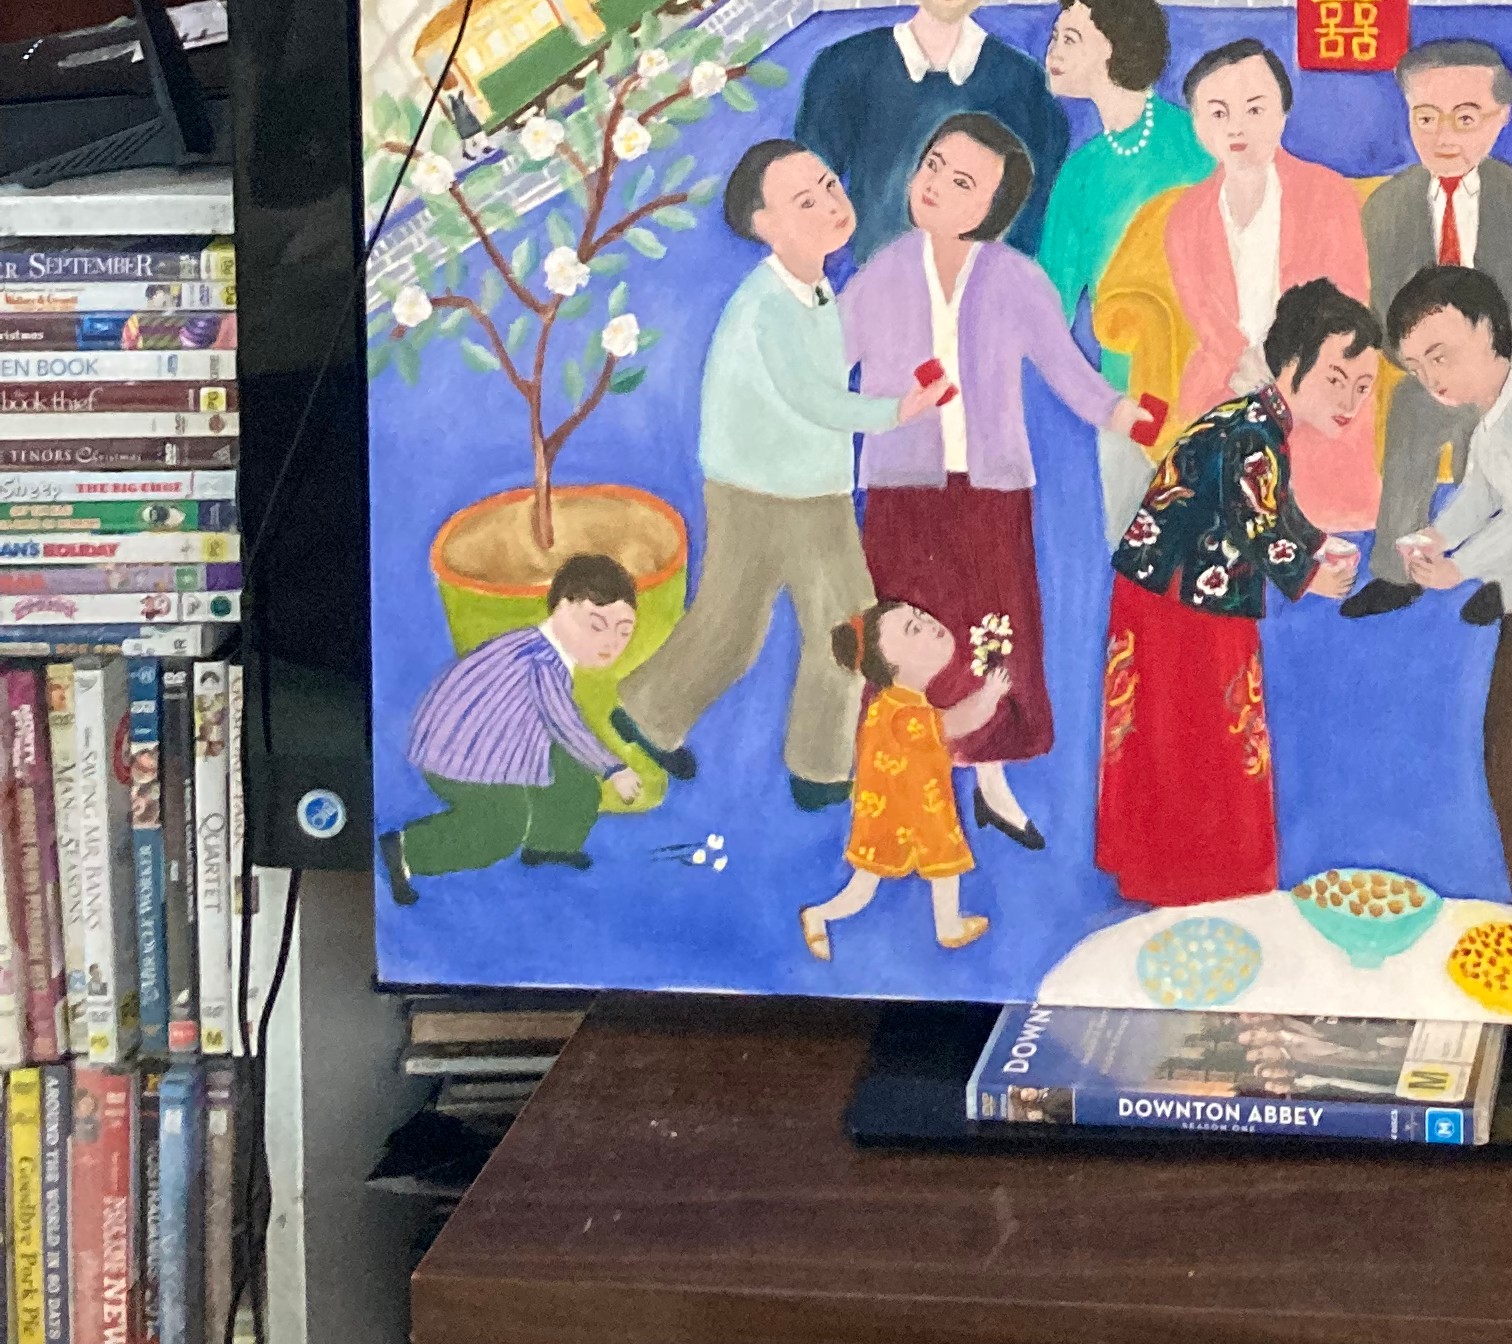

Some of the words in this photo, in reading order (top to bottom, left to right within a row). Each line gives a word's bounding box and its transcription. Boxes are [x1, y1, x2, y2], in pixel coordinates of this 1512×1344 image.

[28, 251, 154, 280] SEPTEMBER
[36, 358, 100, 377] BOOK
[0, 390, 48, 412] book
[51, 386, 104, 412] thief
[10, 449, 73, 463] TENORS
[197, 812, 225, 915] QUARTET
[1003, 1002, 1053, 1075] DOWN
[1407, 1069, 1450, 1091] M
[45, 1075, 60, 1147] AROUND
[1117, 1097, 1241, 1124] DOWNTON
[1247, 1104, 1324, 1127] ABBEY
[45, 1149, 60, 1183] THE
[18, 1155, 37, 1247] Goodbye
[46, 1188, 60, 1246] WORLD
[21, 1253, 39, 1301] Pork
[23, 1305, 40, 1337] Pie
